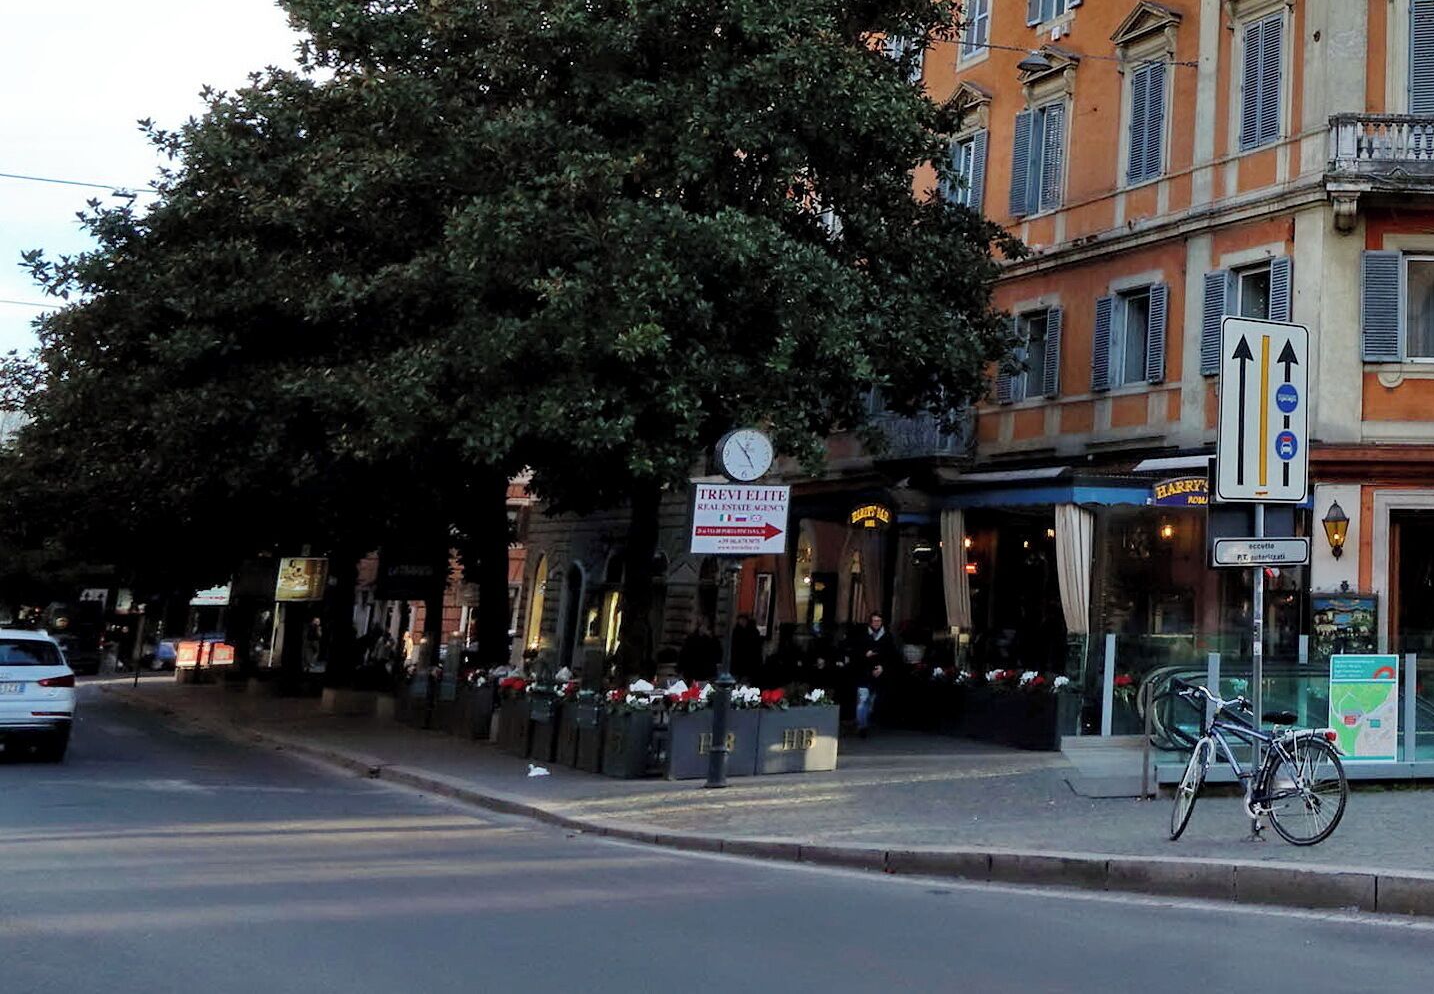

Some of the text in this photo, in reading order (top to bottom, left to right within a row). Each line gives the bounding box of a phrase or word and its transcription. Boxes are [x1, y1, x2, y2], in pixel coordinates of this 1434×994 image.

[699, 489, 787, 502] TREVI ELITE
[697, 503, 785, 512] REAL ESTATE AGENCY
